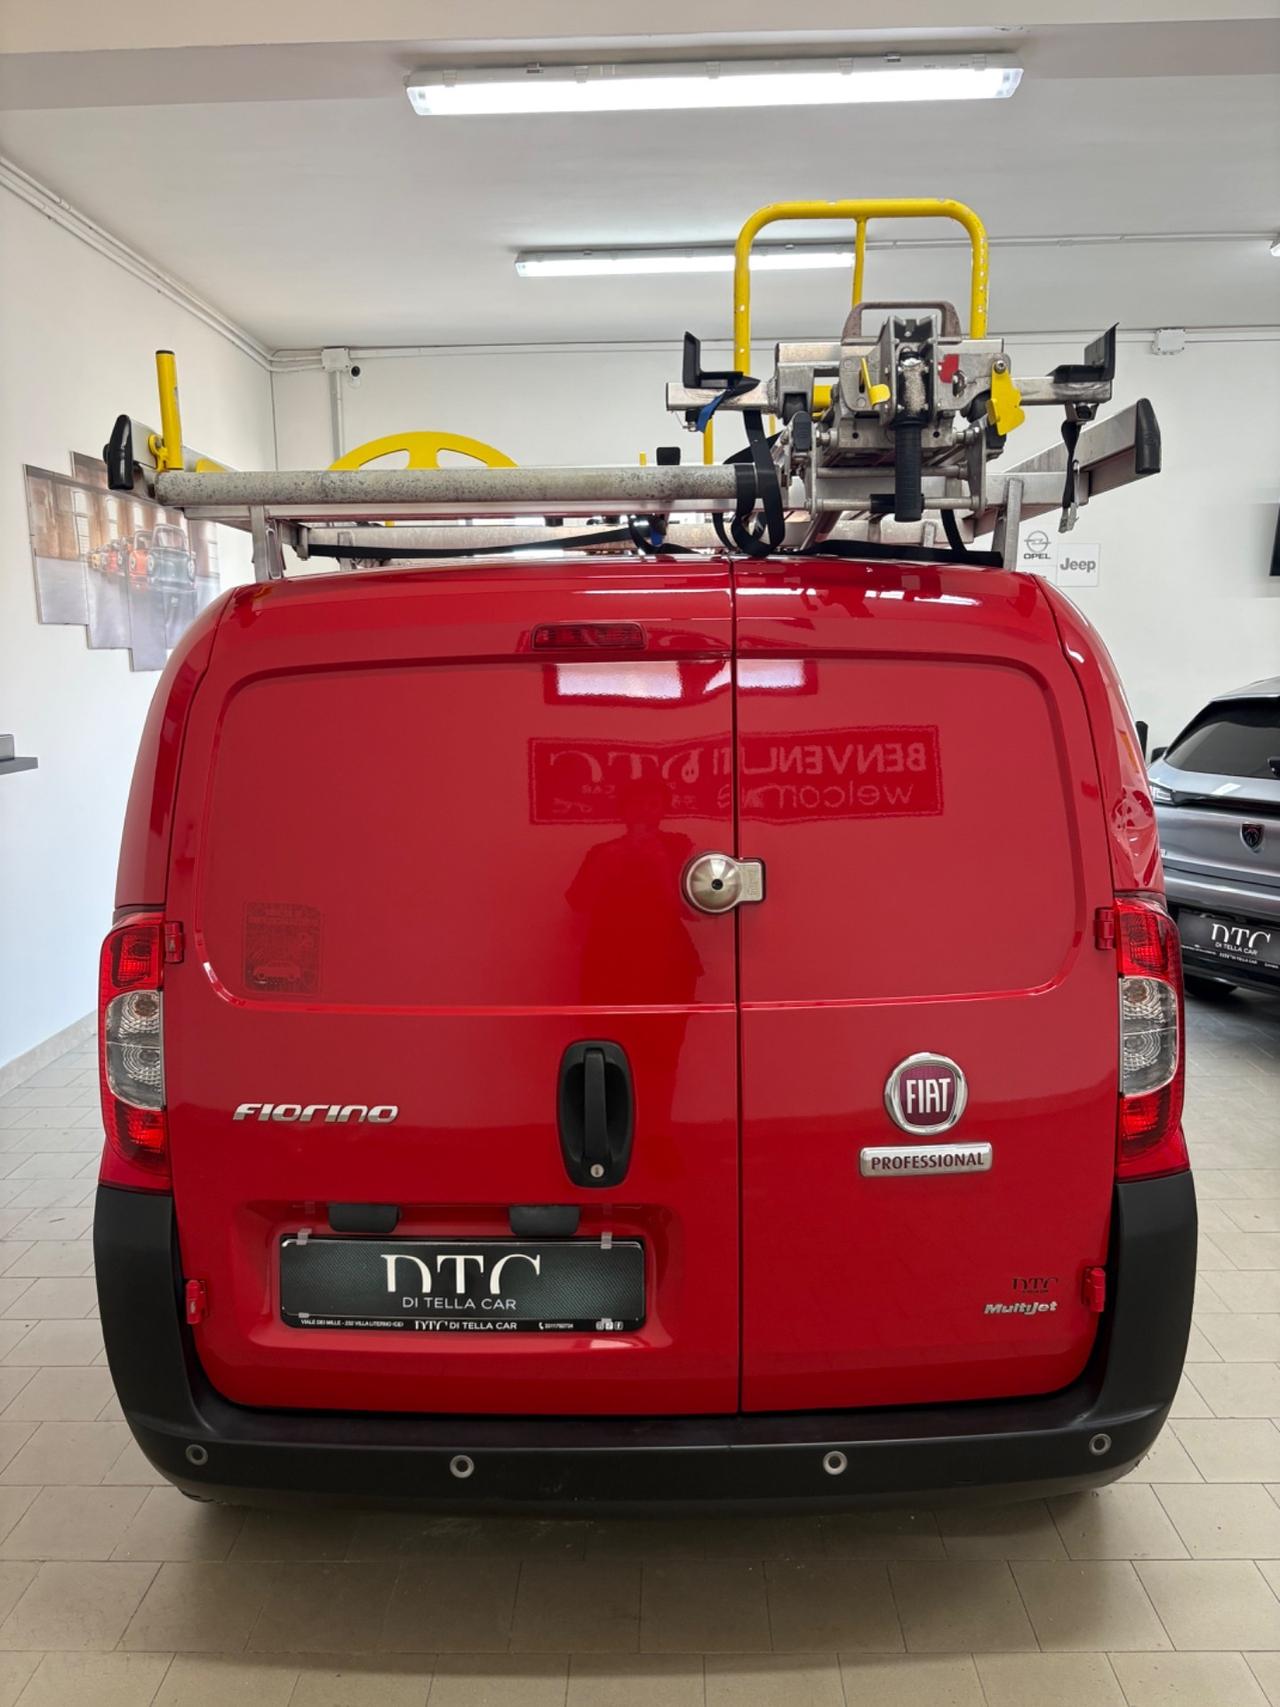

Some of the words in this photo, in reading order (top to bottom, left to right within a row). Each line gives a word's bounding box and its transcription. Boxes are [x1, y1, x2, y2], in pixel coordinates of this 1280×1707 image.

[1060, 558, 1096, 573] Jeep
[1211, 923, 1271, 948] DTC
[906, 1078, 951, 1114] FIAT
[871, 1152, 984, 1170] PROFESSIONAL
[381, 1254, 541, 1294] DTC
[402, 1297, 418, 1308] DI
[424, 1298, 476, 1309] TELLA
[481, 1299, 516, 1310] CAR
[462, 1322, 493, 1330] TELLA
[496, 1322, 517, 1330] CAR
